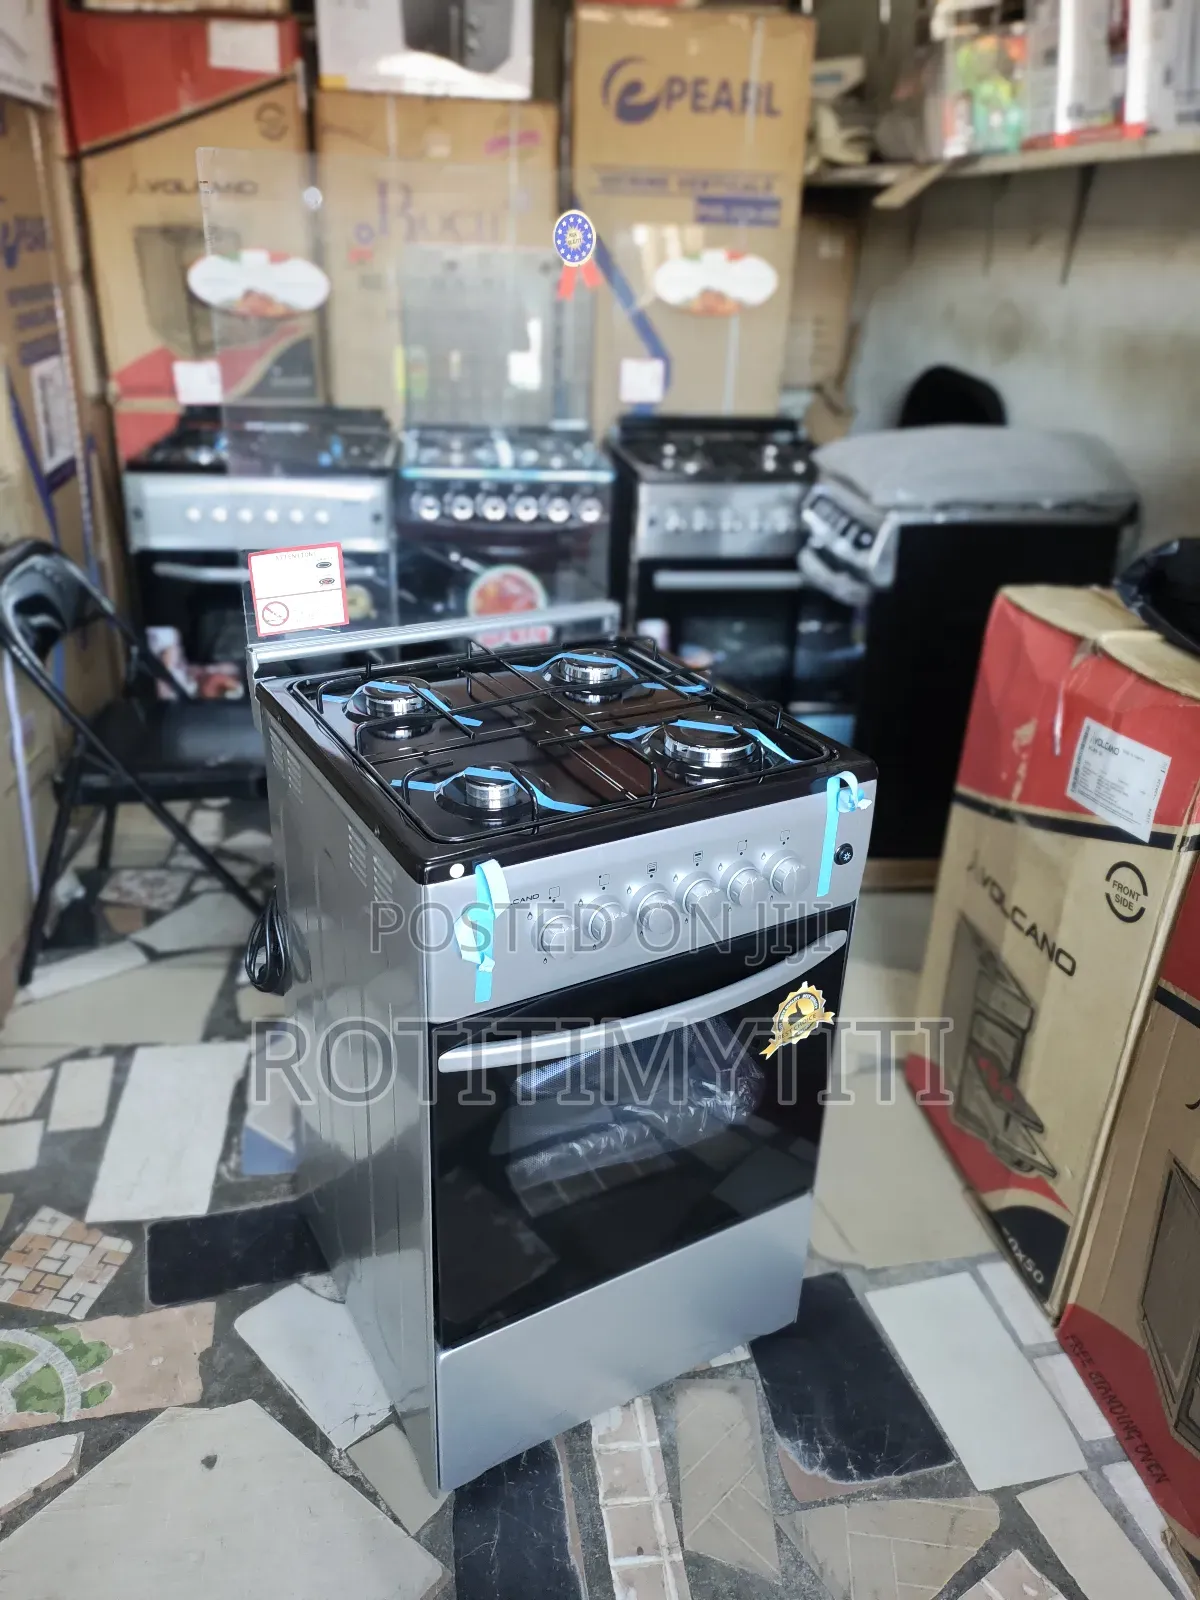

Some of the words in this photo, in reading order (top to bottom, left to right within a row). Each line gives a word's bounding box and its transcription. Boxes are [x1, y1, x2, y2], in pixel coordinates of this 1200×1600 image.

[665, 74, 783, 118] PEARL
[1092, 736, 1120, 756] VOLCANO
[1112, 880, 1141, 901] FRONT
[1114, 893, 1134, 912] SIDE
[980, 866, 1077, 977] VOLCANO
[777, 1027, 793, 1041] BEST
[794, 1012, 817, 1031] CHOICE
[1065, 1334, 1095, 1368] FREE
[1088, 1371, 1144, 1441] STANDING
[1134, 1442, 1171, 1484] OVEN
